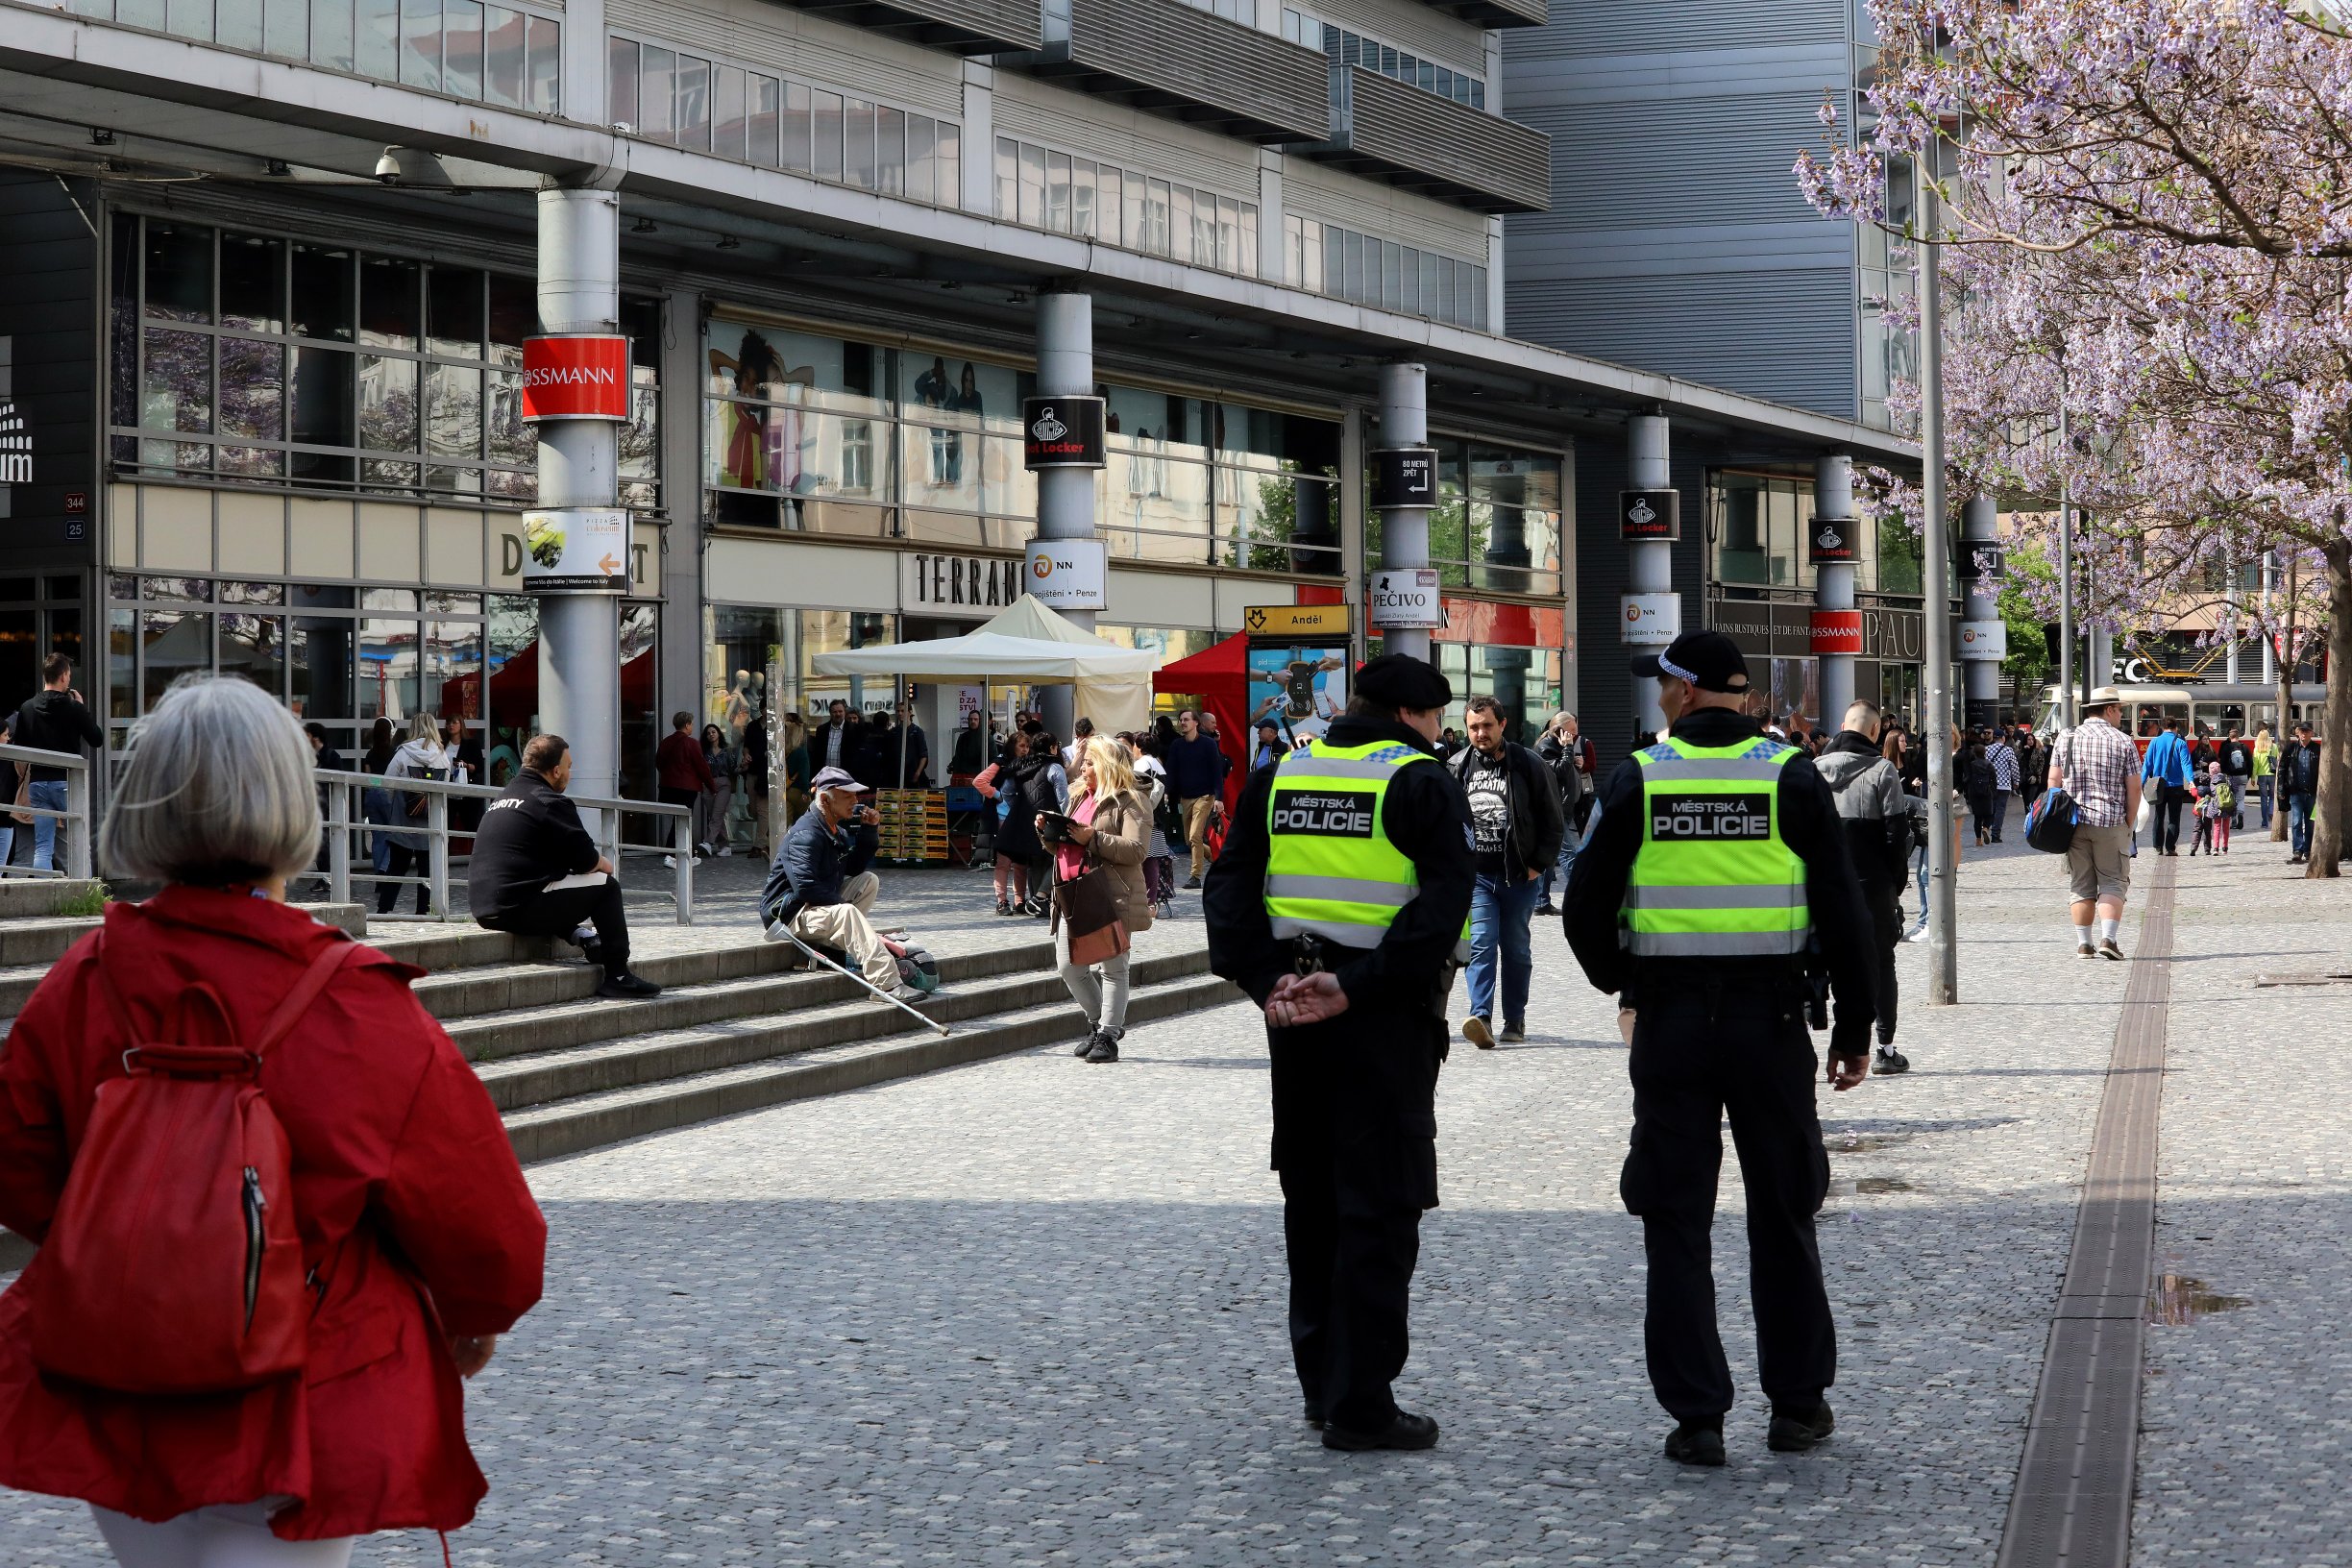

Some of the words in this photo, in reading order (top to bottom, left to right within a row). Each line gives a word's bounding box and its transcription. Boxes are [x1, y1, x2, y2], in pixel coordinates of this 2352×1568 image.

[524, 367, 614, 387] OSSMANN
[1042, 442, 1085, 453] Locker
[1411, 459, 1429, 468] METRŮ
[67, 498, 84, 508] 344
[69, 525, 82, 535] 25
[1637, 524, 1668, 532] Locker
[1056, 561, 1073, 570] NN
[916, 553, 1025, 606] TERRAN
[1076, 589, 1097, 598] Penze
[1373, 589, 1426, 607] PEČIVO
[1291, 615, 1323, 625] Anděl
[1734, 623, 1770, 636] RUSTIQUES
[1773, 625, 1782, 635] ET
[1782, 625, 1793, 635] DE
[1793, 625, 1810, 636] FANT
[486, 798, 525, 813] CURITY
[1290, 795, 1356, 810] MĚSTSKÁ
[1672, 799, 1749, 813] MĚSTSKÁ
[1273, 809, 1372, 832] POLICIE
[1654, 815, 1769, 836] POLICIE
